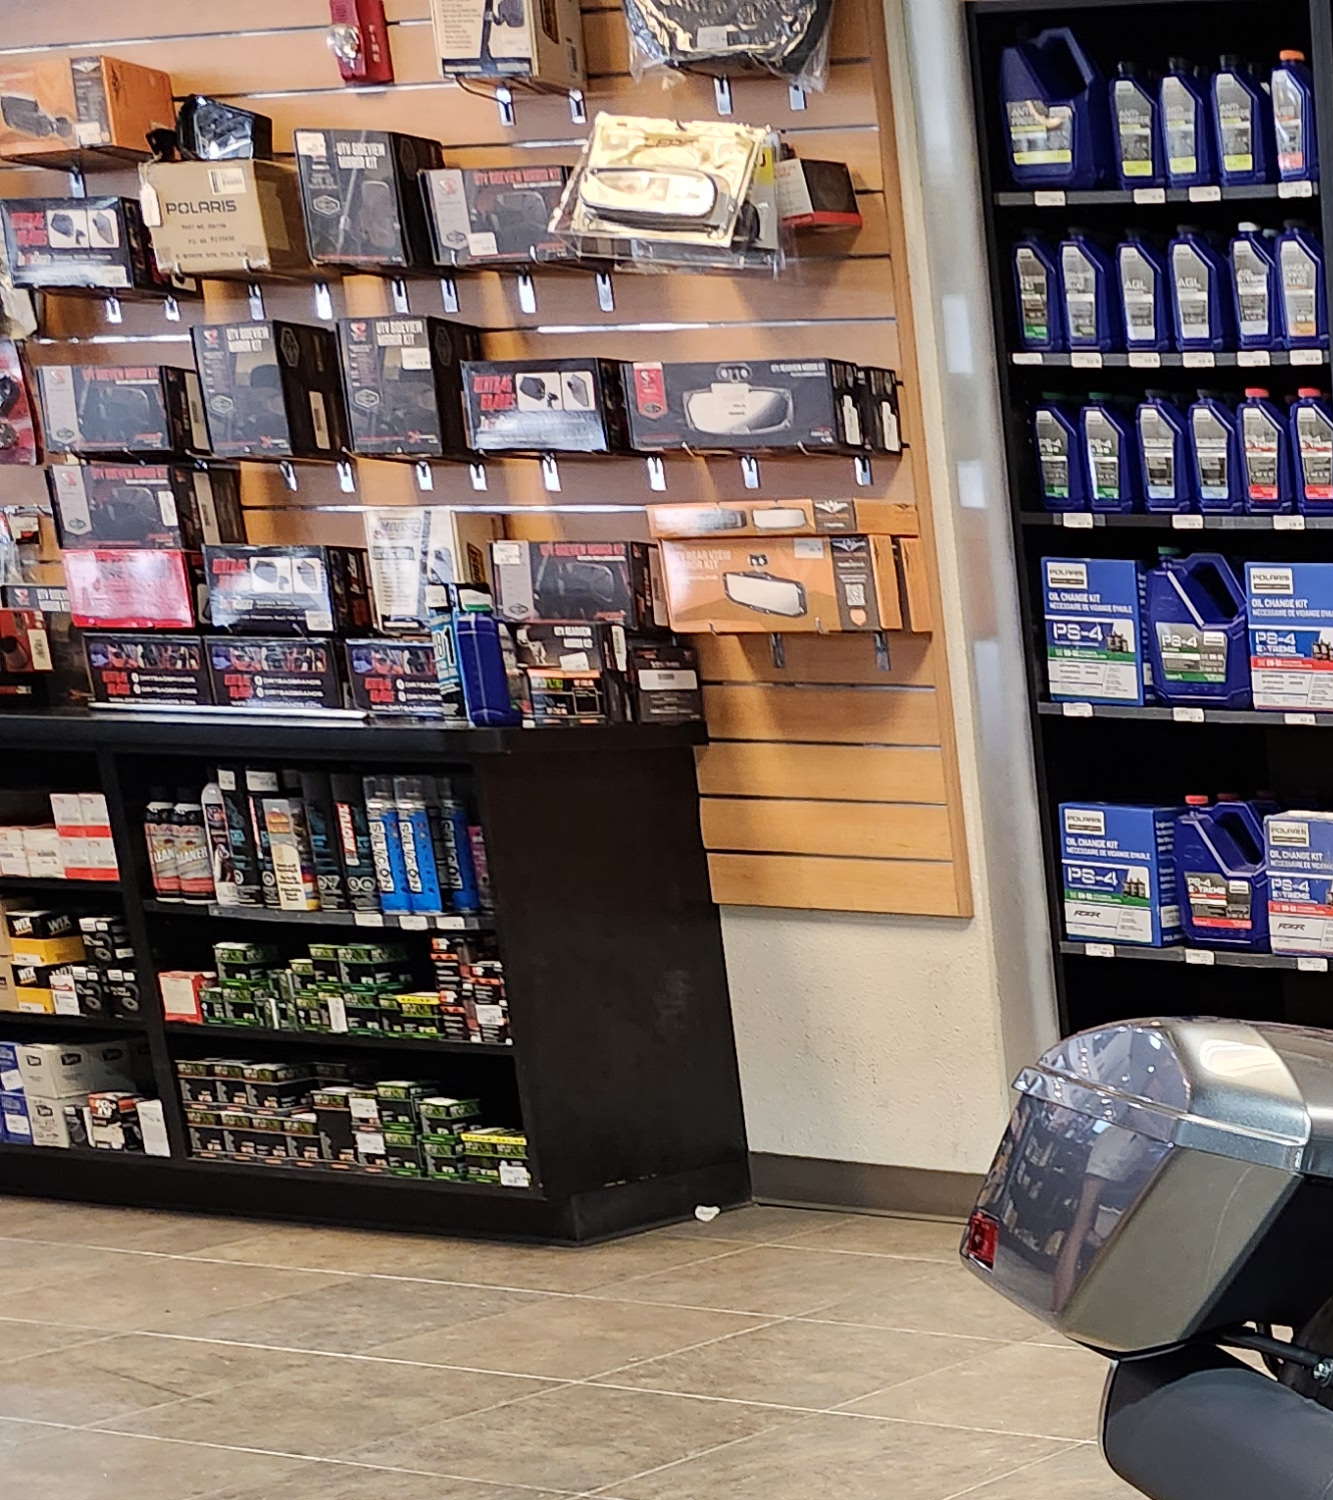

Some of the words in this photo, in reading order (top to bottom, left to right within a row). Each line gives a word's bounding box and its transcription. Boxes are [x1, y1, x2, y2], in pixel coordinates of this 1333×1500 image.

[166, 200, 237, 215] POLARIS
[1125, 280, 1146, 289] AGL
[1178, 278, 1201, 288] AGL
[1264, 599, 1294, 608] CHANGE
[1296, 599, 1308, 609] KIT
[1053, 623, 1103, 641] PS-4
[1256, 631, 1296, 645] PS-4
[1162, 634, 1198, 648] PS-4
[1068, 867, 1118, 885] PS-4
[1272, 879, 1310, 891] PS-4
[13, 917, 32, 931] WIX
[47, 915, 71, 931] WIX
[18, 966, 35, 980] WIX
